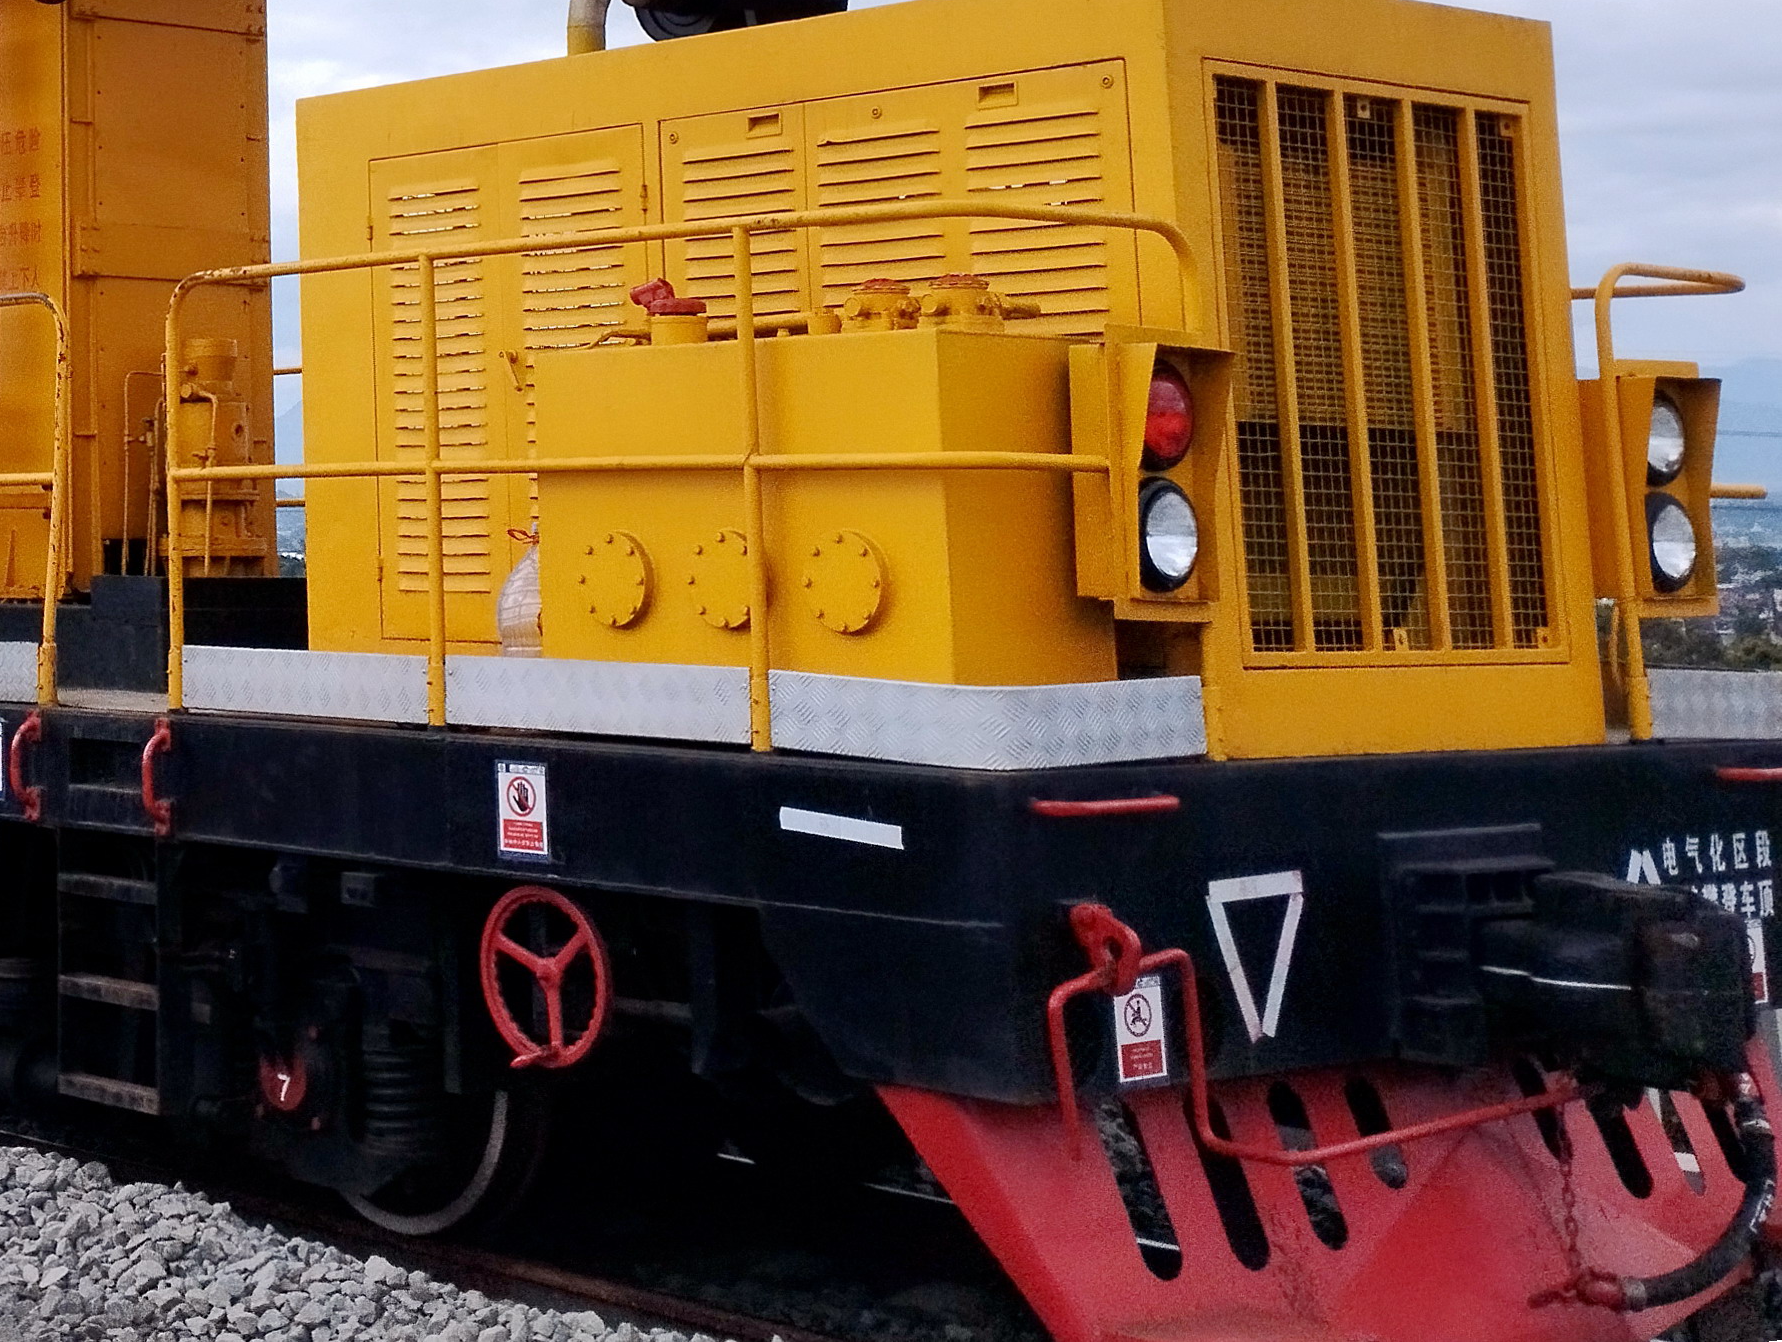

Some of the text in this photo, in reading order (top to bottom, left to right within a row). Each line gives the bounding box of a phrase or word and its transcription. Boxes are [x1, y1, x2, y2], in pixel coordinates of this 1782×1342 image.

[1662, 829, 1772, 876] 电气化区段
[277, 1073, 291, 1102] 7
